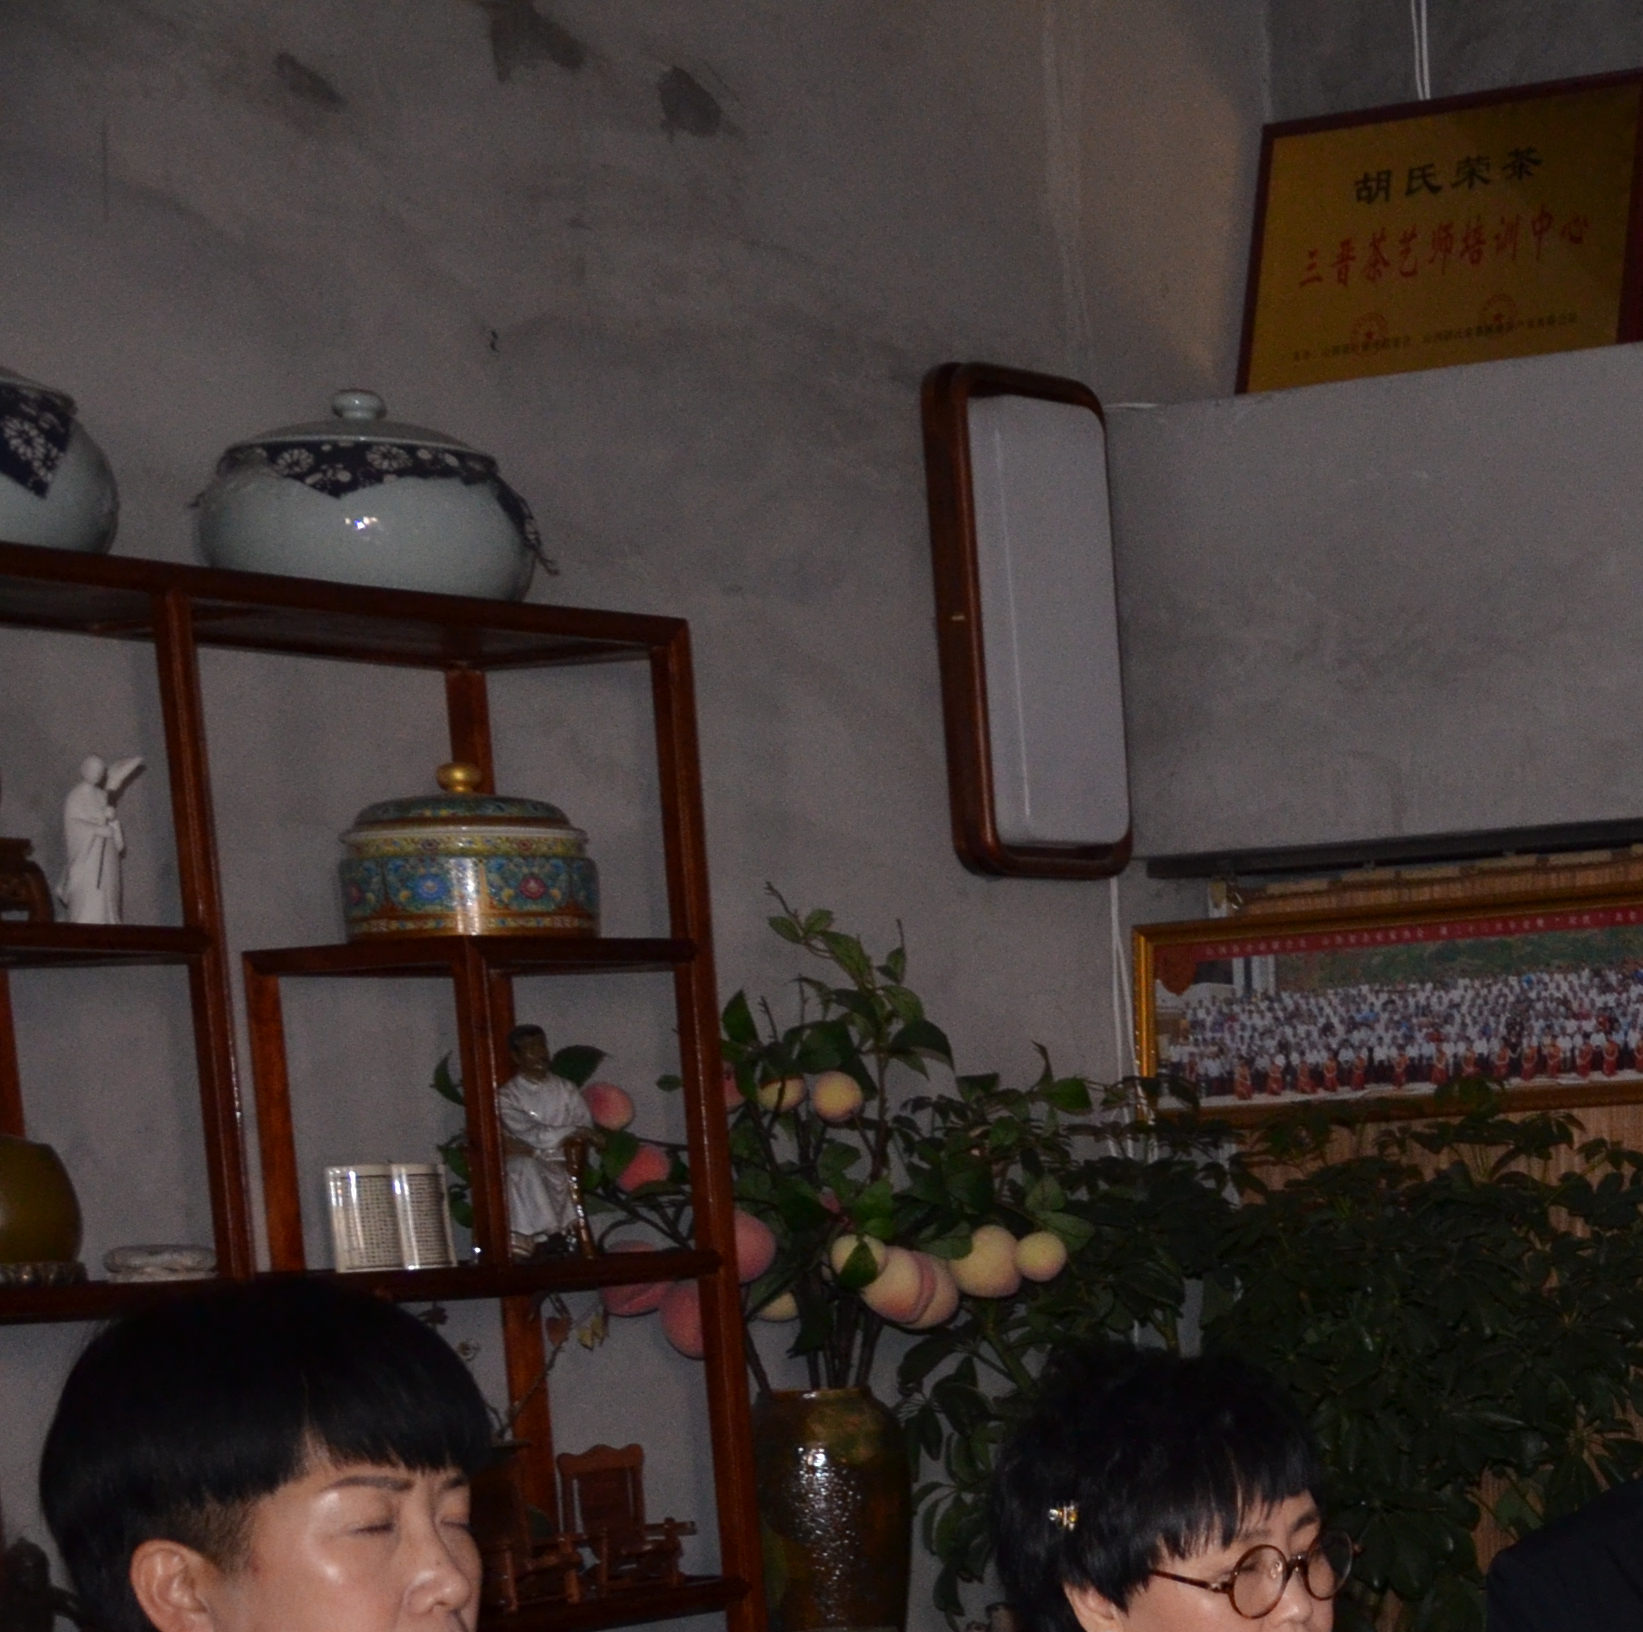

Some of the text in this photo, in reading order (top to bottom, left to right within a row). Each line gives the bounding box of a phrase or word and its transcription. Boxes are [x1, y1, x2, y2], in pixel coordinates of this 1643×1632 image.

[1354, 146, 1543, 205] 胡氏荣茶
[1299, 203, 1590, 288] 三晋茶艺师培训中心
